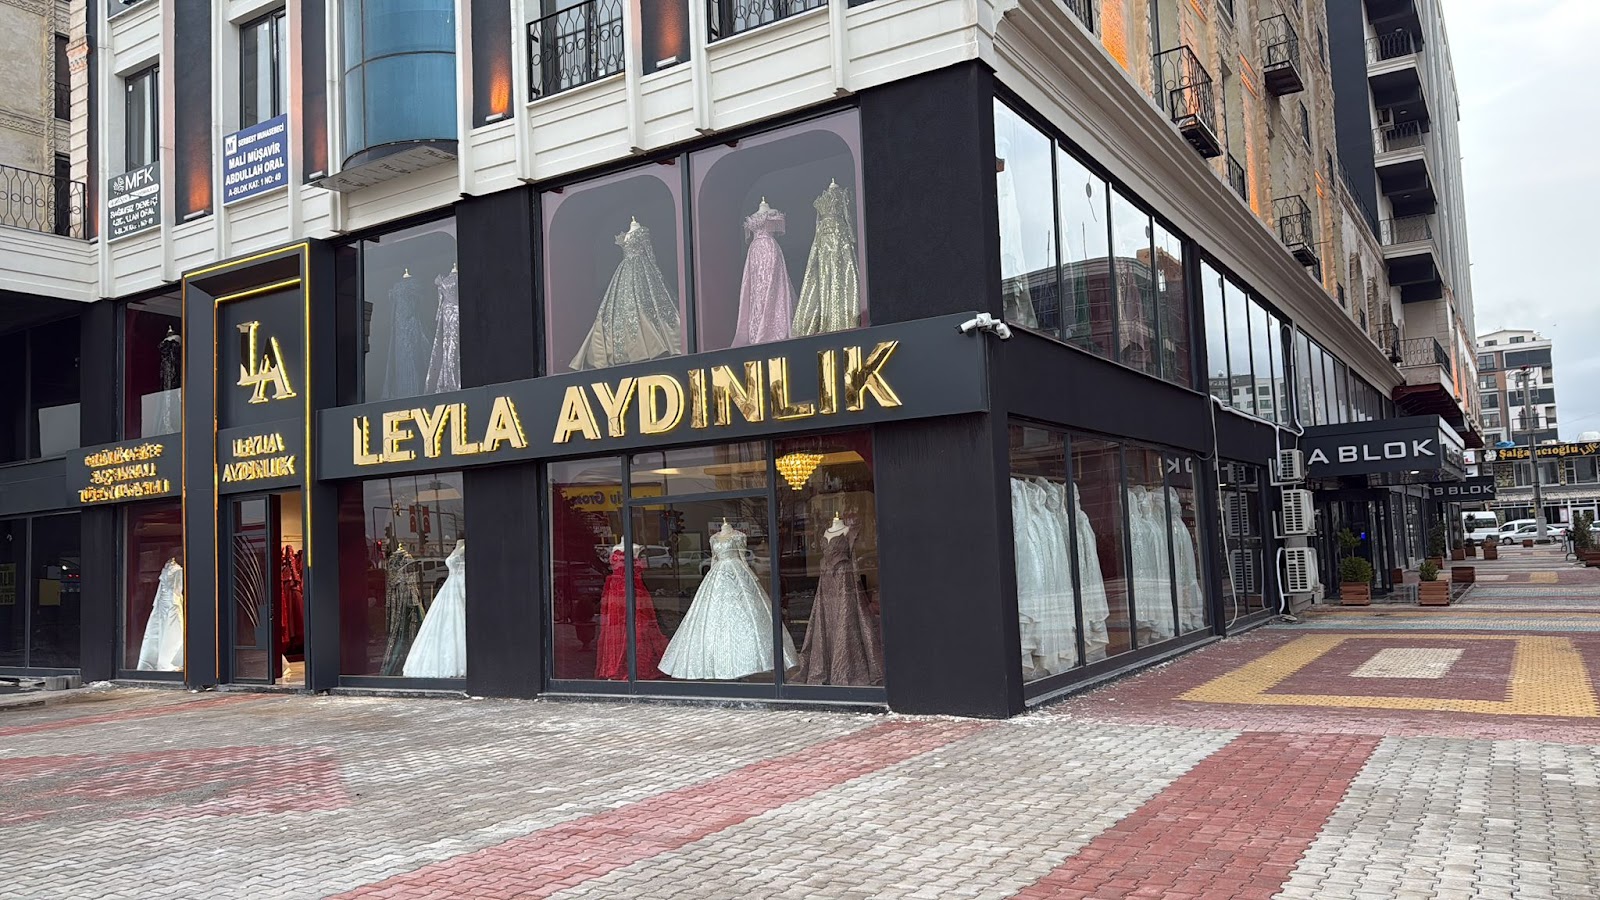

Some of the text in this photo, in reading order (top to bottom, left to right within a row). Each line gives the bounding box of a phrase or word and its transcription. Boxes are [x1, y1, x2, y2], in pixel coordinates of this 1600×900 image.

[238, 134, 256, 147] SERBEST
[229, 141, 281, 170] MALİ MÜŞAVİR
[125, 166, 154, 191] MFK
[225, 156, 285, 186] ABDULLAH ORAL
[228, 183, 248, 197] A-BLOK
[352, 340, 902, 466] LEYLA AYDINLIK
[232, 432, 285, 457] LEYLA
[1307, 438, 1436, 465] A BLOK
[1580, 442, 1599, 456] Life
[222, 455, 296, 483] AYDINLIK
[1433, 485, 1494, 496] B BLOK
